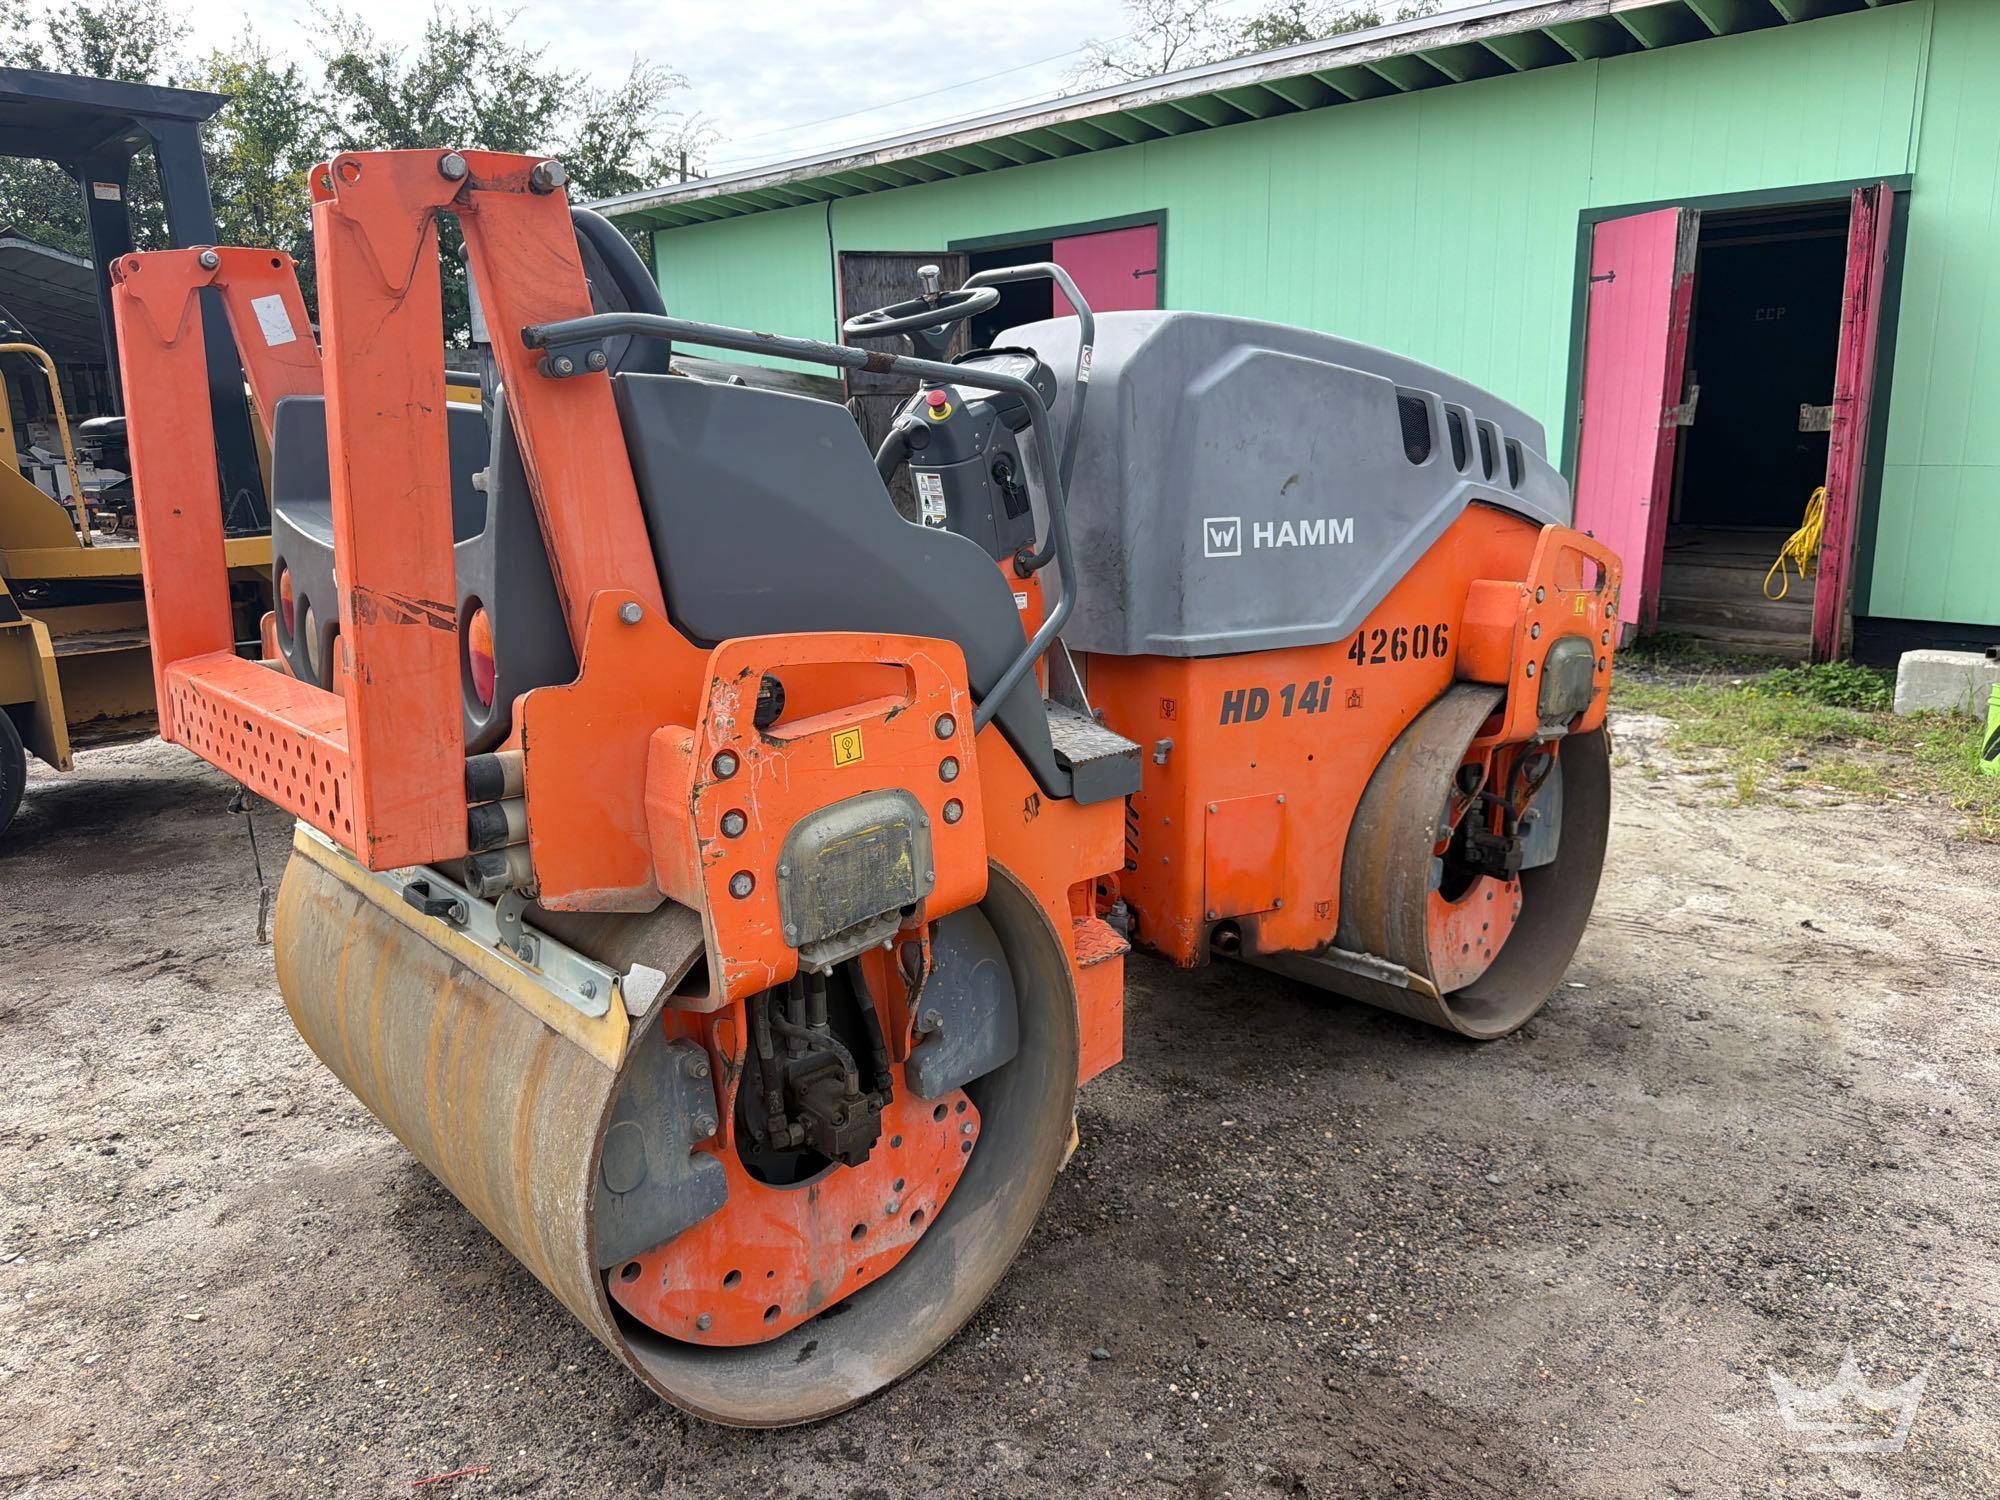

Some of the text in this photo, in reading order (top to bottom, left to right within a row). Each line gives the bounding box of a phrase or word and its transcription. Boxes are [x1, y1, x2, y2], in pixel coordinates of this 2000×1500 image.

[1253, 518, 1354, 549] HAMM
[1348, 623, 1448, 666] 42606
[1219, 675, 1333, 725] HD 14i
